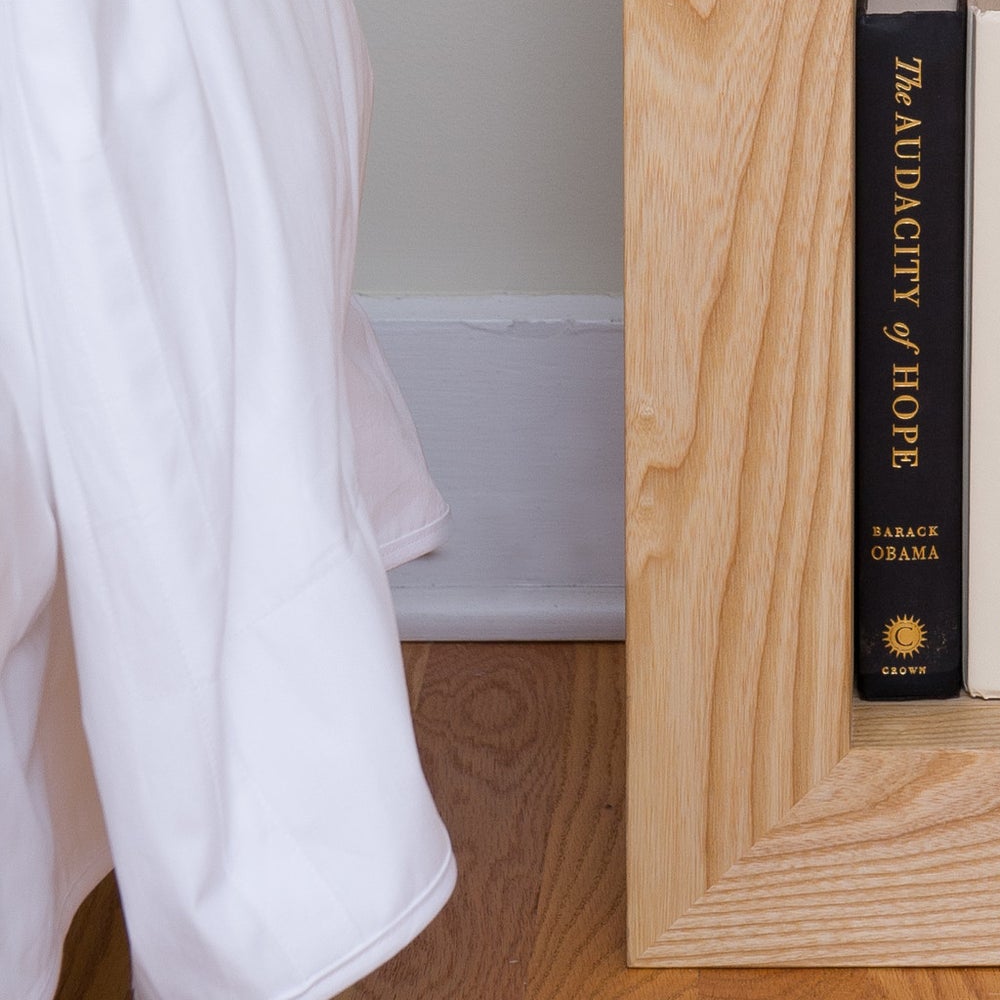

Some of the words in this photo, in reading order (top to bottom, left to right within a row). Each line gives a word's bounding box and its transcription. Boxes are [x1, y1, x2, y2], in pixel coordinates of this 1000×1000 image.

[894, 56, 923, 107] The
[893, 111, 922, 308] AUDACITY
[883, 321, 920, 356] of
[892, 363, 920, 469] HOPE
[872, 525, 939, 538] BARACK
[871, 545, 940, 561] OBAMA
[881, 665, 927, 676] CROWN
